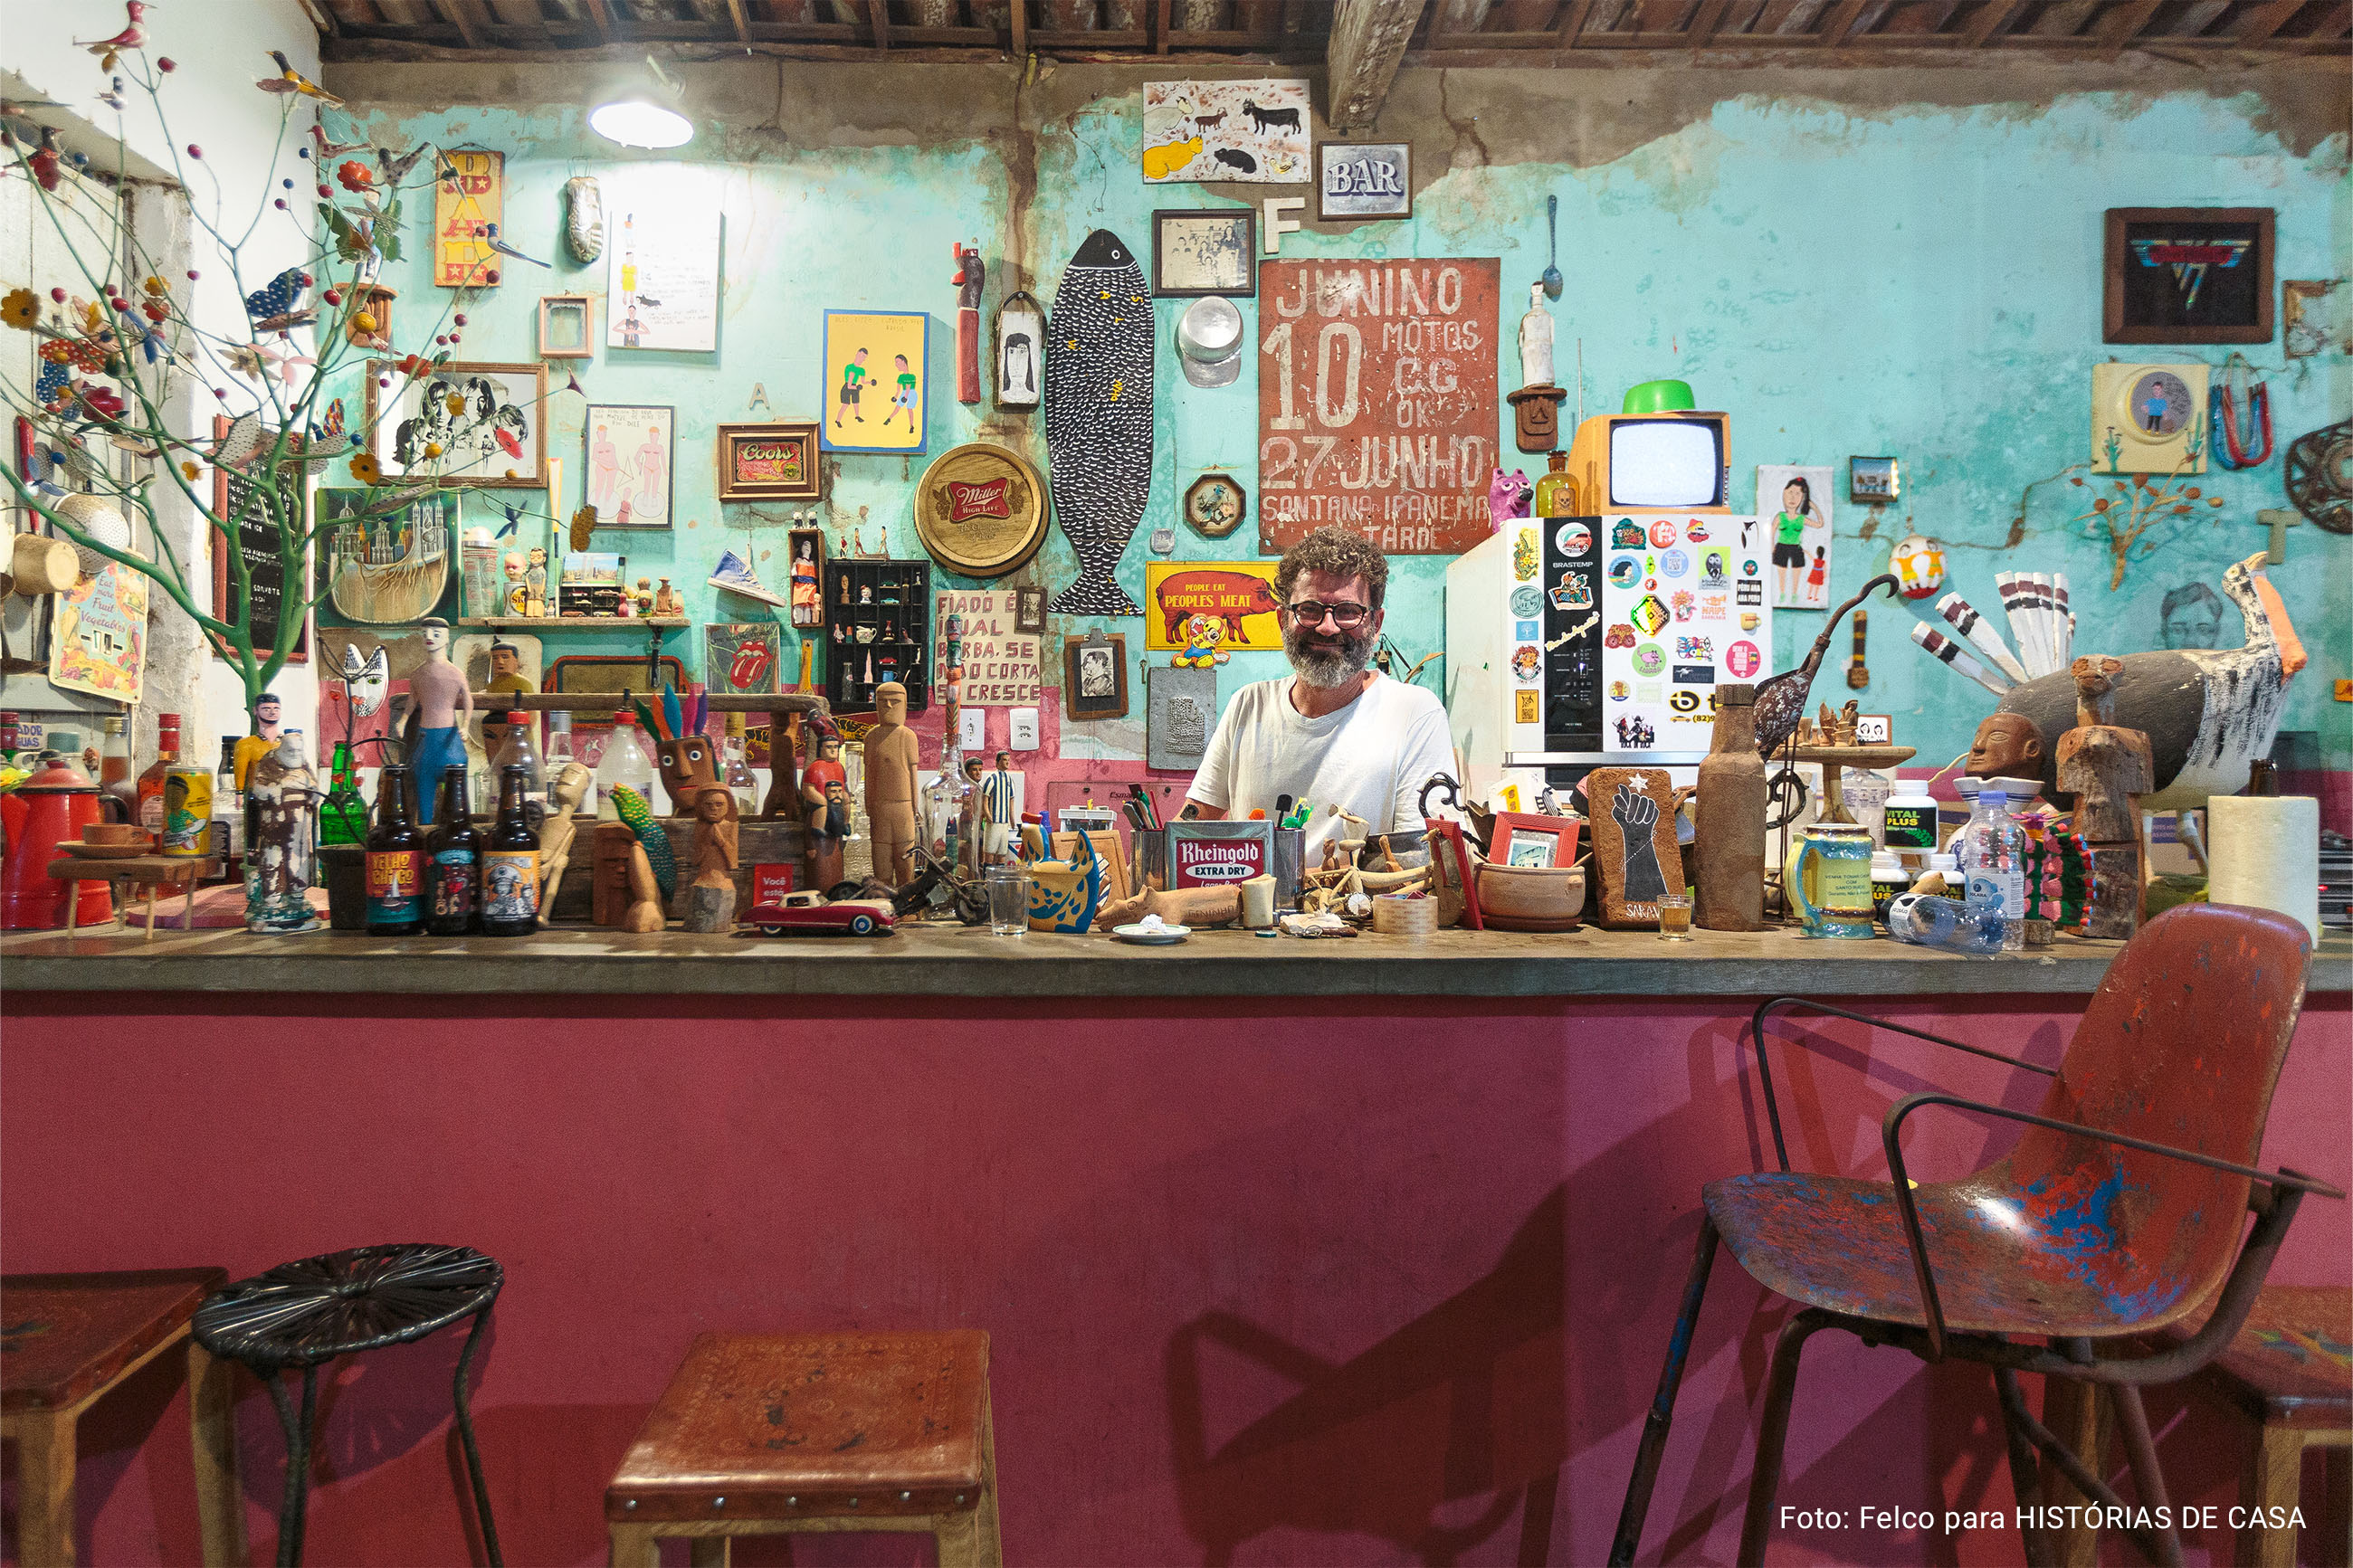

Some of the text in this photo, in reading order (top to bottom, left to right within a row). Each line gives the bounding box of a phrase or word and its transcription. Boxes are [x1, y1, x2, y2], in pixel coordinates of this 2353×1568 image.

[1328, 158, 1404, 196] BAR
[1263, 196, 1305, 254] F
[1275, 268, 1462, 318] JUNINO
[1261, 323, 1363, 431] 10
[1394, 356, 1459, 394] CG
[748, 382, 770, 411] A
[740, 443, 795, 461] Coors
[1260, 435, 1485, 489] 27 JUNHO
[956, 487, 1002, 506] Miller
[1262, 495, 1373, 522] SANTANA
[1384, 495, 1491, 522] IPANEMA
[2256, 508, 2303, 565] T
[1552, 561, 1594, 569] BRASTEMP
[99, 575, 112, 588] Eat
[1185, 584, 1225, 592] PEOPLE EAT
[92, 597, 116, 613] Fruit
[1164, 594, 1252, 608] PEOPLES MEAT
[81, 610, 126, 634] Vegetables
[938, 615, 1004, 637] IUAL
[938, 641, 1034, 659] BRBA, SE
[986, 662, 1040, 680] CORTA
[967, 684, 1041, 701] CRESCE
[17, 725, 43, 736] ADOR
[1885, 810, 1920, 819] VITAL
[1887, 818, 1919, 826] PLUS
[1180, 841, 1259, 866] Rheingold
[1195, 867, 1246, 876] EXTRA DRY
[763, 877, 786, 886] Você
[1626, 904, 1664, 919] SARAV
